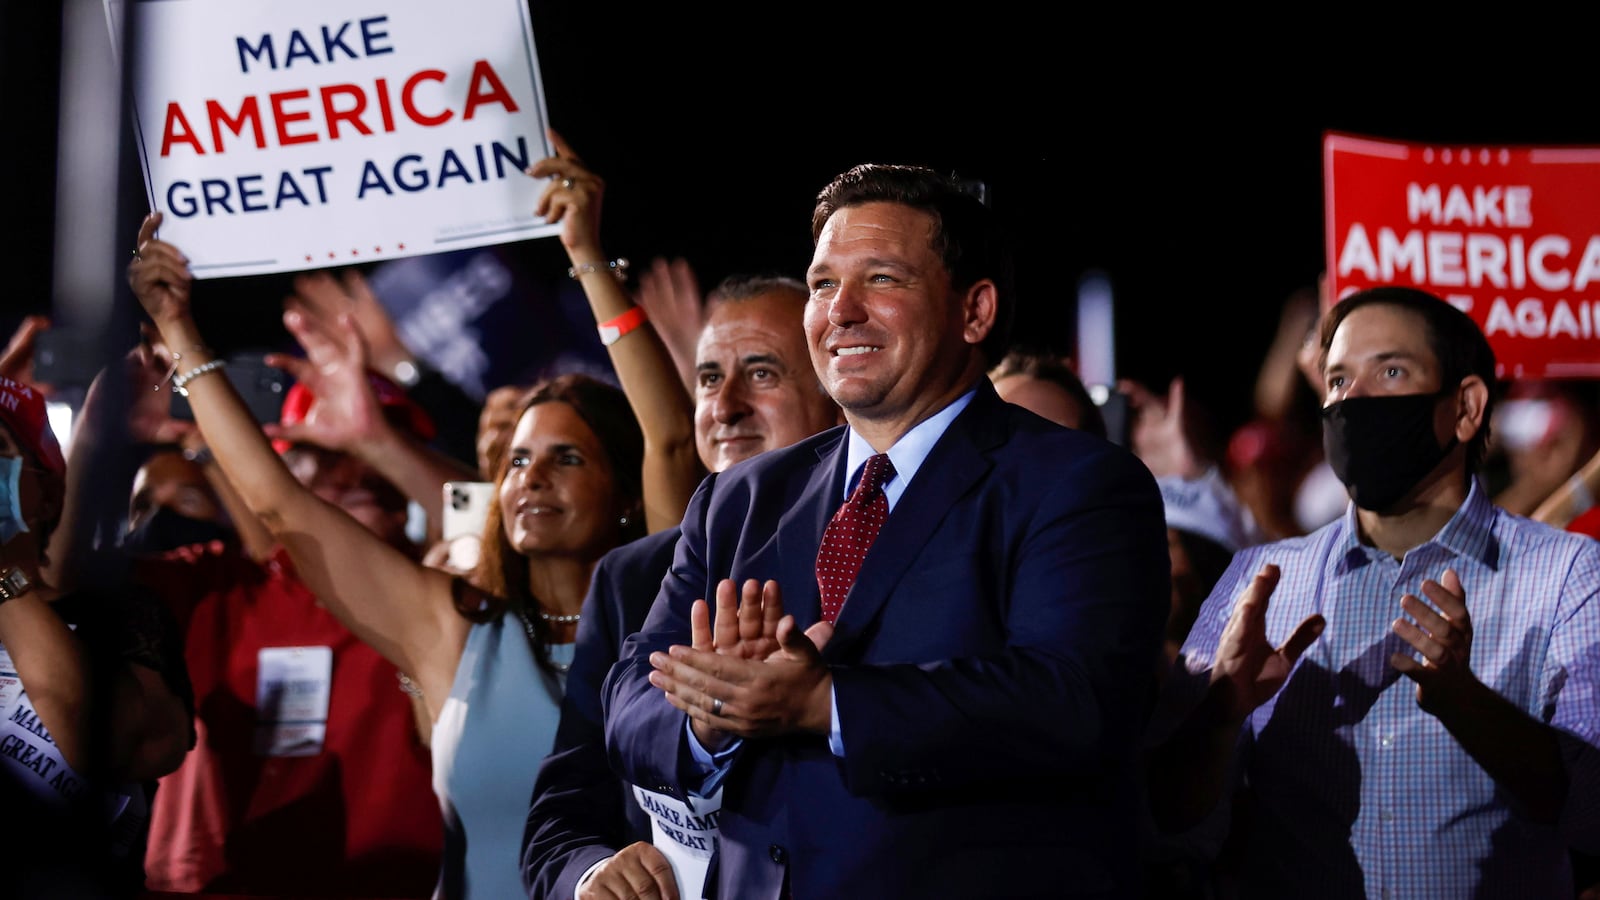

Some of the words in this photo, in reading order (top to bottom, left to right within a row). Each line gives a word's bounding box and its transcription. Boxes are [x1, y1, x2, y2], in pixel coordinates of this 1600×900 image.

[235, 15, 394, 73] MAKE
[160, 59, 520, 158] AMERICA
[166, 166, 333, 218] GREAT
[357, 136, 530, 199] AGAIN
[1406, 181, 1533, 228] MAKE
[1338, 222, 1600, 292] AMERICA
[1484, 296, 1600, 340] AGAI
[0, 734, 57, 778] GREAT
[640, 790, 685, 828] MAKE
[657, 819, 709, 851] GREAT
